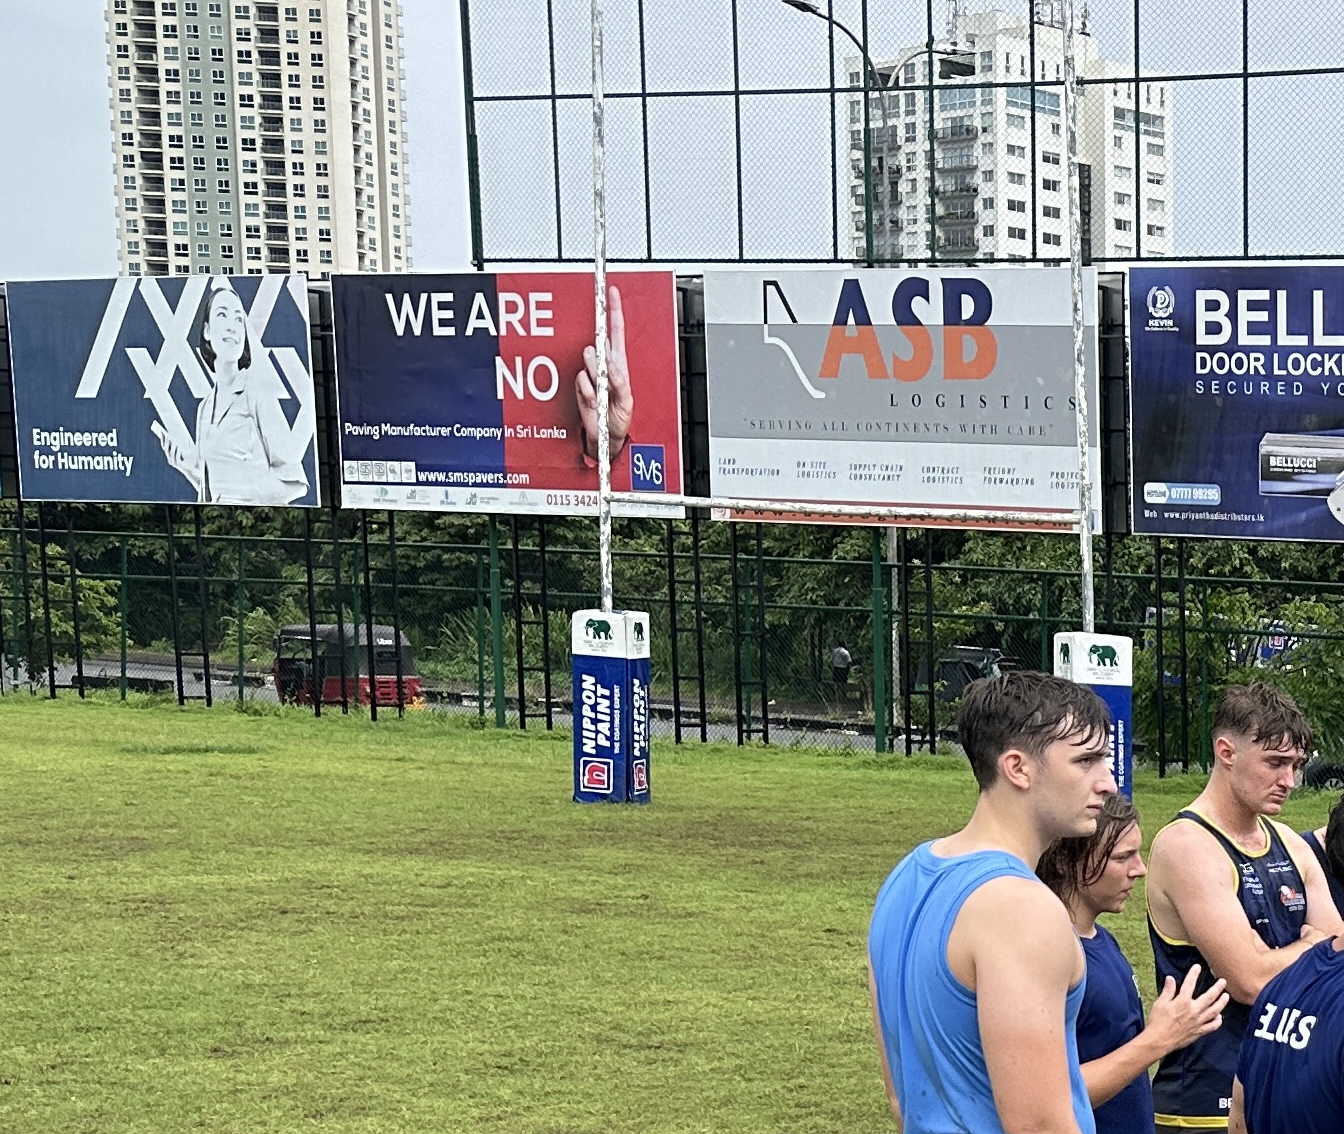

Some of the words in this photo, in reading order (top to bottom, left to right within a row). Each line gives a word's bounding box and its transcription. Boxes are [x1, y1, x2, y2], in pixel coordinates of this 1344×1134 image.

[384, 292, 456, 337] WE
[465, 292, 555, 337] ARE
[818, 277, 998, 382] ASB
[1195, 352, 1265, 376] DOOR
[495, 355, 560, 402] NO
[1195, 380, 1303, 396] SECURED
[889, 392, 1077, 411] LOGISTICS
[32, 426, 118, 452] Engineered
[344, 422, 380, 440] Paving
[381, 423, 451, 437] Manufacturer
[453, 424, 503, 440] Company
[505, 425, 515, 438] In
[516, 425, 532, 439] Sri
[533, 426, 567, 439] Lanka
[821, 420, 849, 432] ALL
[856, 421, 950, 434] CONTINENTS
[959, 423, 999, 435] WITH
[33, 449, 56, 469] for
[57, 450, 134, 477] Humanity
[1269, 455, 1317, 469] BELLUCCI
[417, 470, 530, 486] www.smspavers.com
[546, 493, 571, 506] 0115
[581, 673, 596, 755] NIPPON
[597, 683, 611, 748] PAINT
